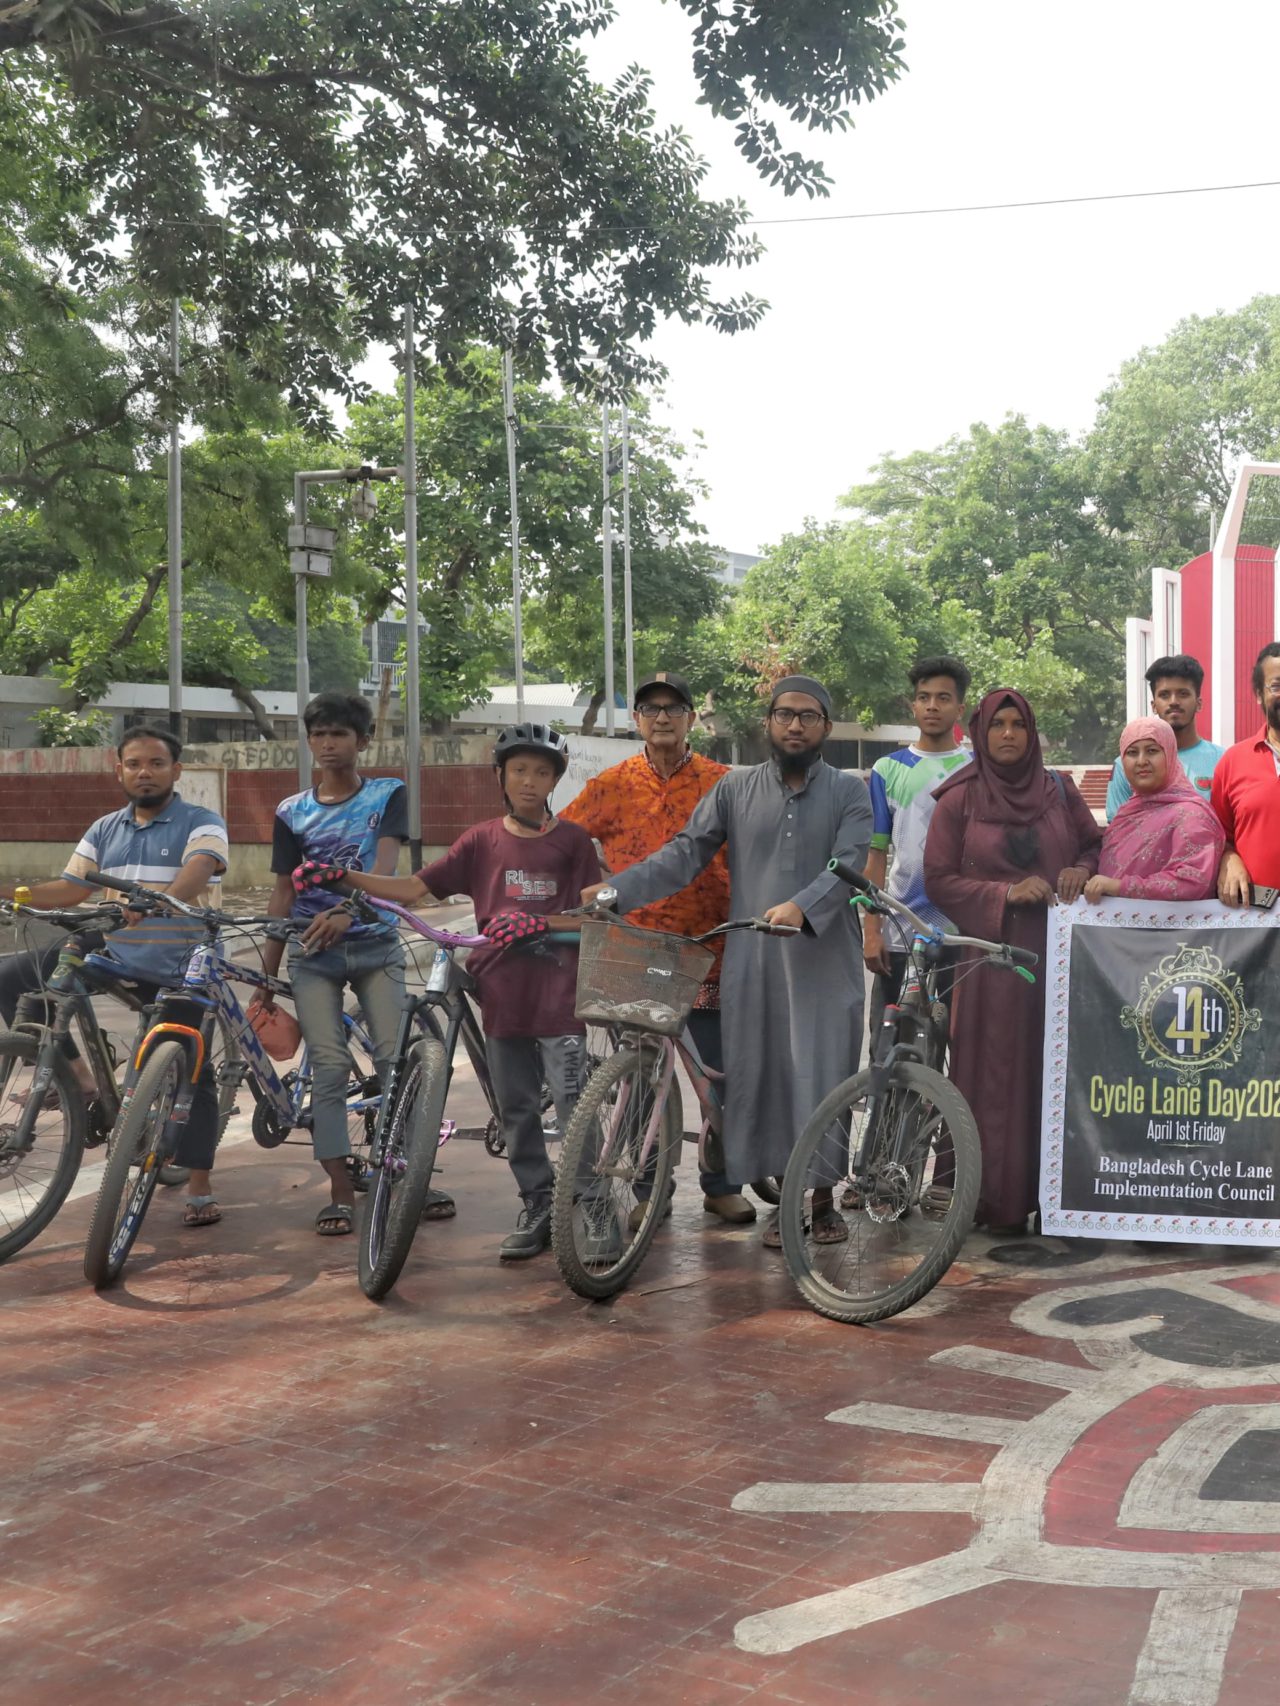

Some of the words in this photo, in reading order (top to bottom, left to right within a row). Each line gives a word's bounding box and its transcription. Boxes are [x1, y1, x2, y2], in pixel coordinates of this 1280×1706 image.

[1165, 986, 1223, 1054] 14th
[1090, 1075, 1145, 1117] Cycle
[1151, 1077, 1201, 1116] Lane
[1146, 1119, 1173, 1141] April
[1174, 1121, 1191, 1141] 1st
[1193, 1121, 1226, 1144] Friday
[1099, 1156, 1186, 1178] Bangladesh
[1189, 1160, 1232, 1182] Cycle
[1236, 1161, 1273, 1179] Lane
[1093, 1178, 1213, 1200] Implementation
[1218, 1183, 1275, 1202] Council
